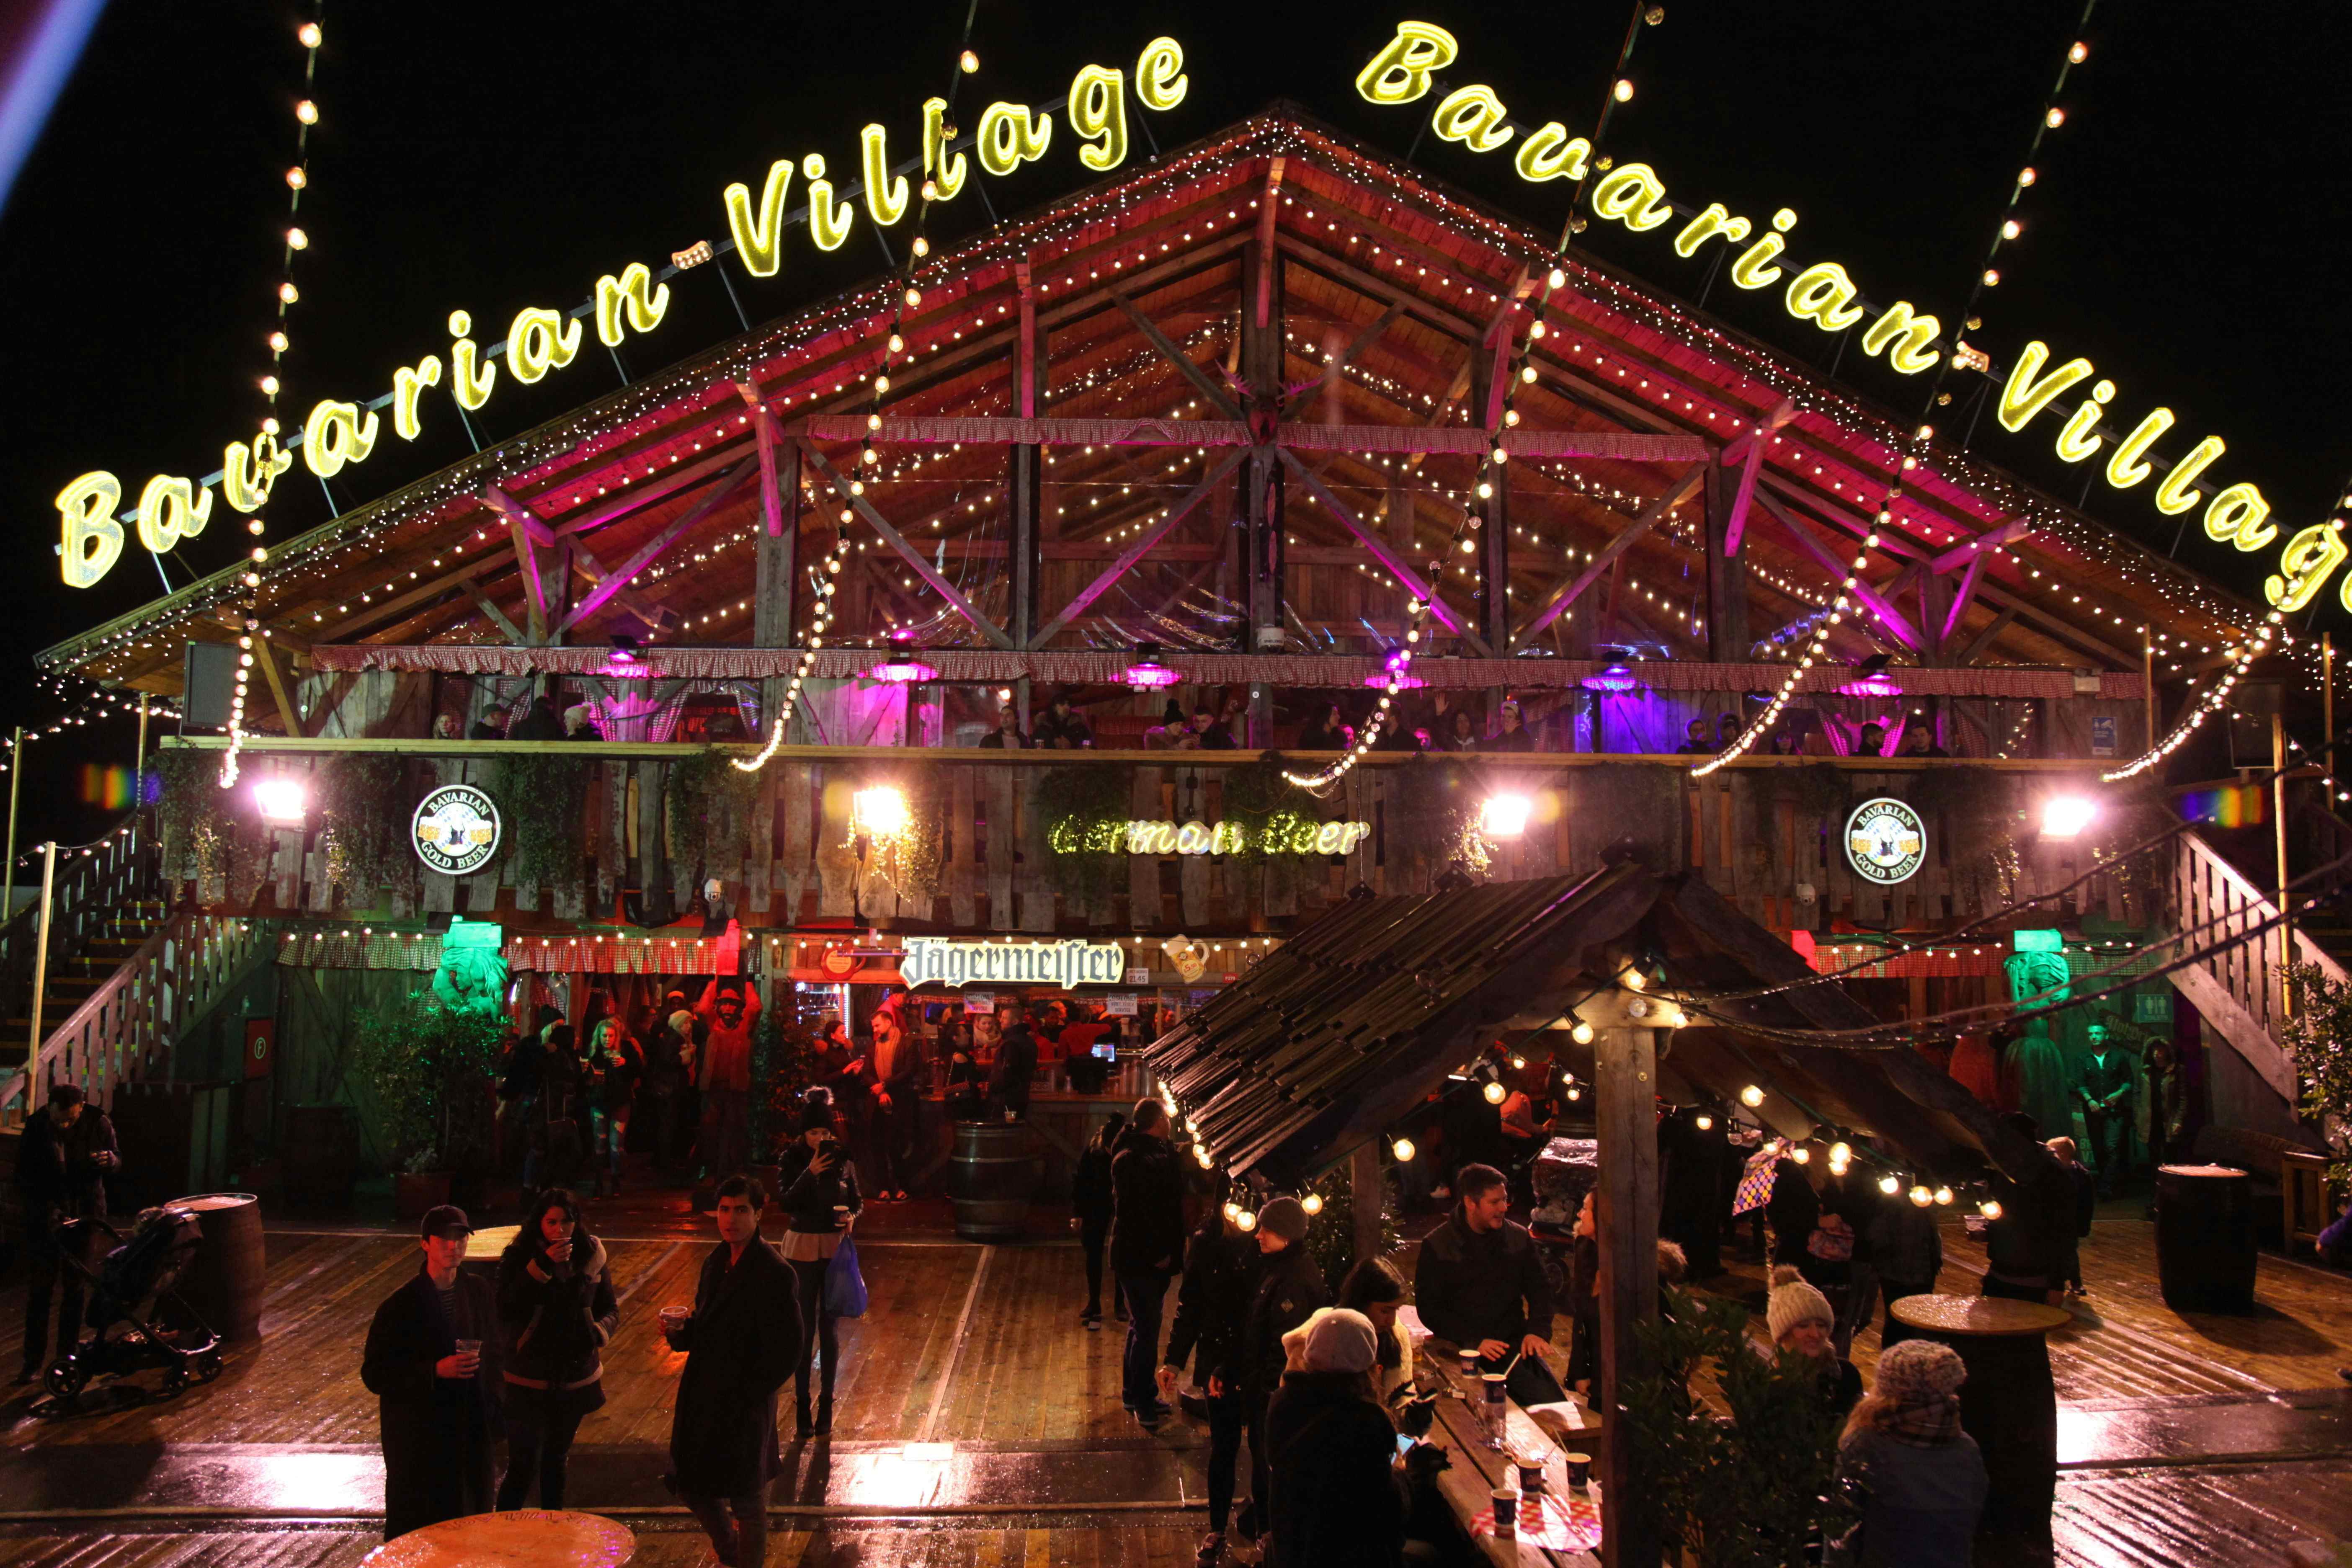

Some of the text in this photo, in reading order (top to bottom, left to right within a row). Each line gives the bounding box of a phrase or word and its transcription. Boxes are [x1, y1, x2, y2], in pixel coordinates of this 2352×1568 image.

[54, 36, 1189, 590] Bavarian Village
[1355, 20, 2352, 614] Bavarian Villag
[428, 792, 490, 816] BAVARIAN
[1857, 805, 1915, 827] BAVARIAN
[421, 841, 489, 868] GOLD BEER
[1856, 854, 1918, 878] GOLD BEER
